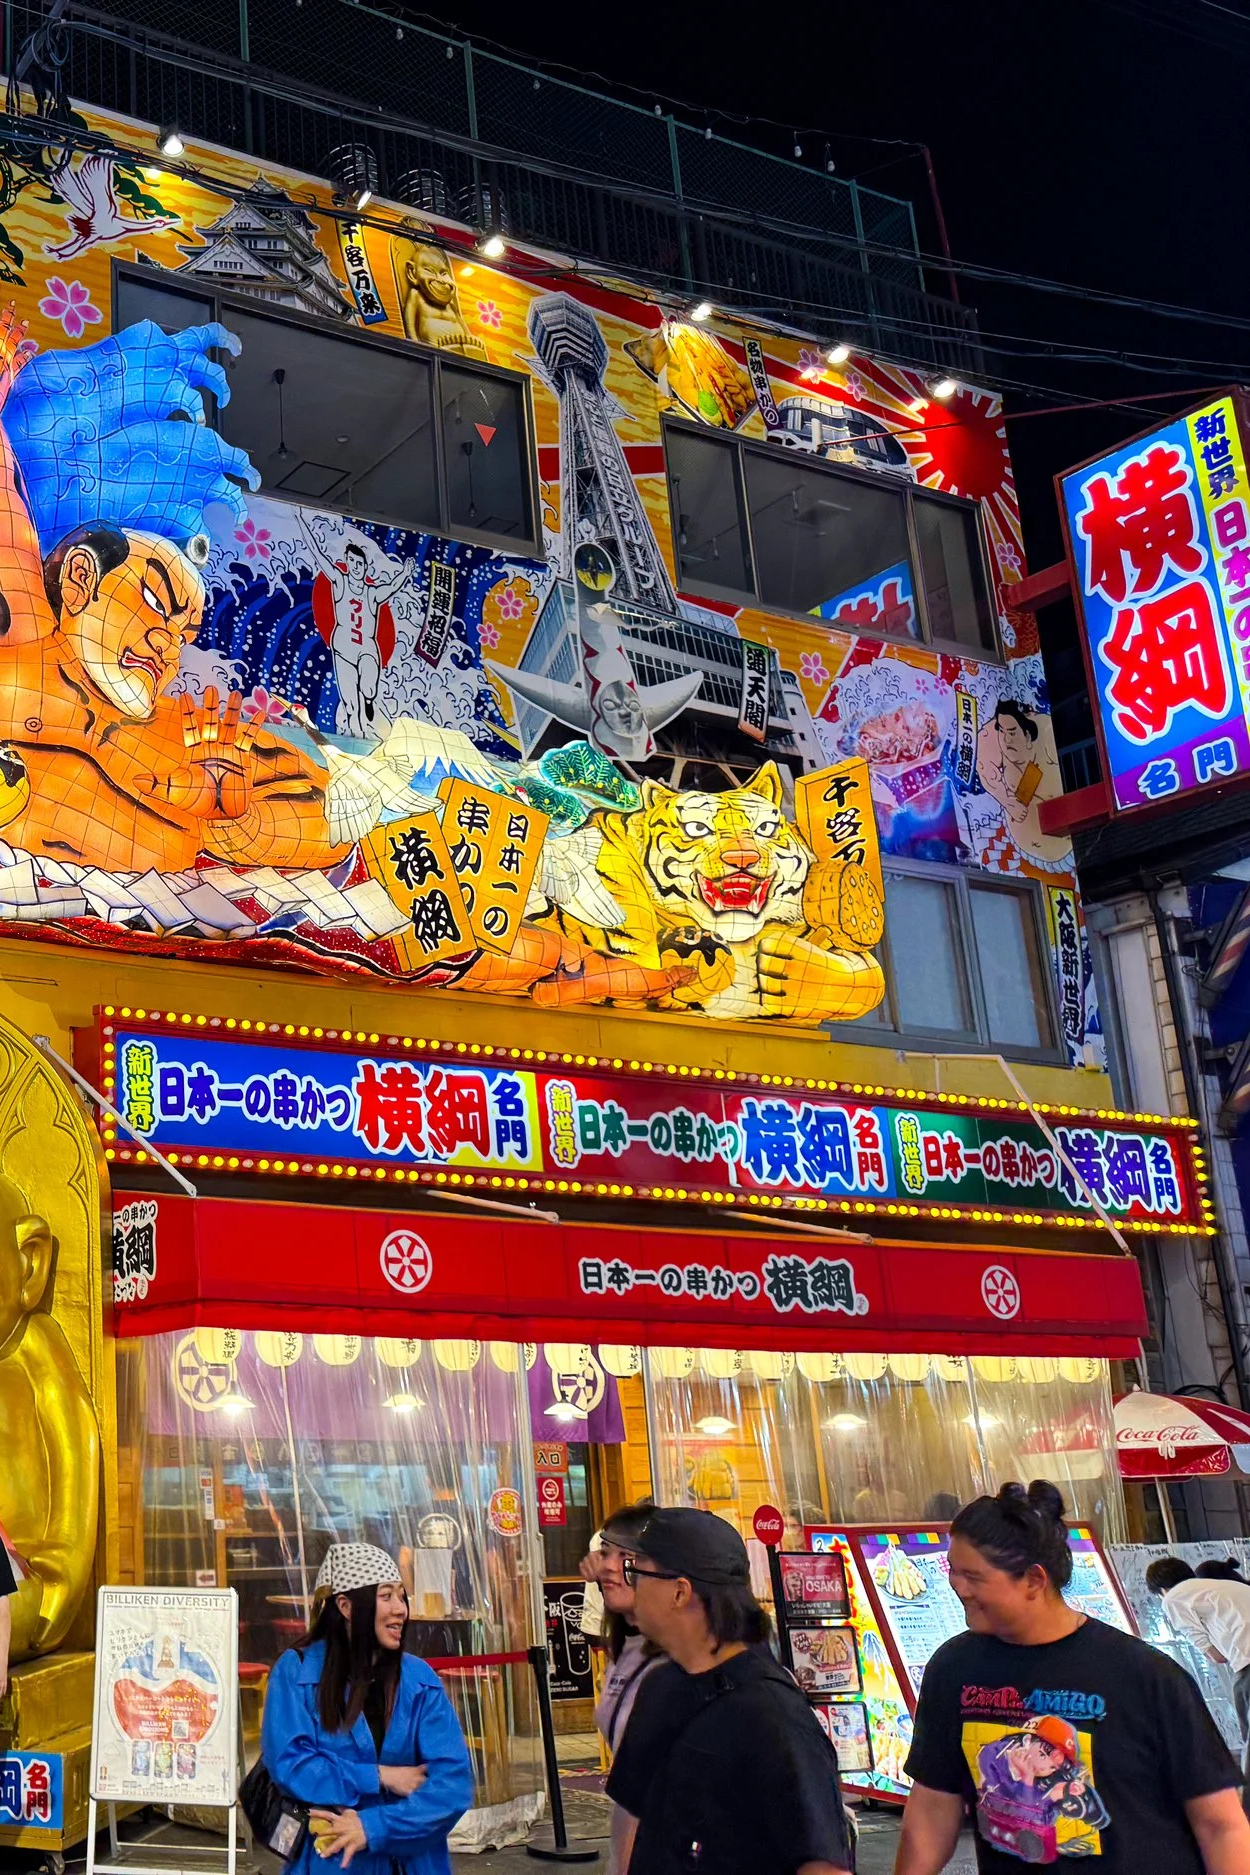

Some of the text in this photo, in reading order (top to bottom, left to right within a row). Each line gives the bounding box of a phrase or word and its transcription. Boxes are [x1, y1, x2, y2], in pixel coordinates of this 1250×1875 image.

[341, 222, 381, 315] 千客万来
[1194, 408, 1238, 499] 新世界
[1081, 447, 1232, 739] 横綱
[744, 645, 767, 731] 通天閣
[956, 698, 974, 784] 日本一の横綱
[1139, 739, 1233, 797] 名門
[389, 826, 462, 955] 横綱
[483, 812, 529, 937] 日本一の
[1055, 891, 1082, 1037] 大阪新世界
[126, 1044, 528, 1159] 新世界 日本一の串かつ 横綱 名門
[550, 1085, 884, 1187] 新世界 日本一の串かつ 横綱 名門
[897, 1116, 1179, 1211] 新世界 日本一の串かつ 横綱 名門
[581, 1257, 854, 1313] 日本一の串かつ 横綱
[537, 1451, 560, 1465] 入口
[1116, 1426, 1200, 1443] Coca-Cola
[756, 1519, 781, 1531] Coca-Cola
[106, 1594, 230, 1607] BILLIKEN DIVERSITY
[805, 1580, 843, 1593] OSAKA
[26, 1763, 49, 1819] 名門
